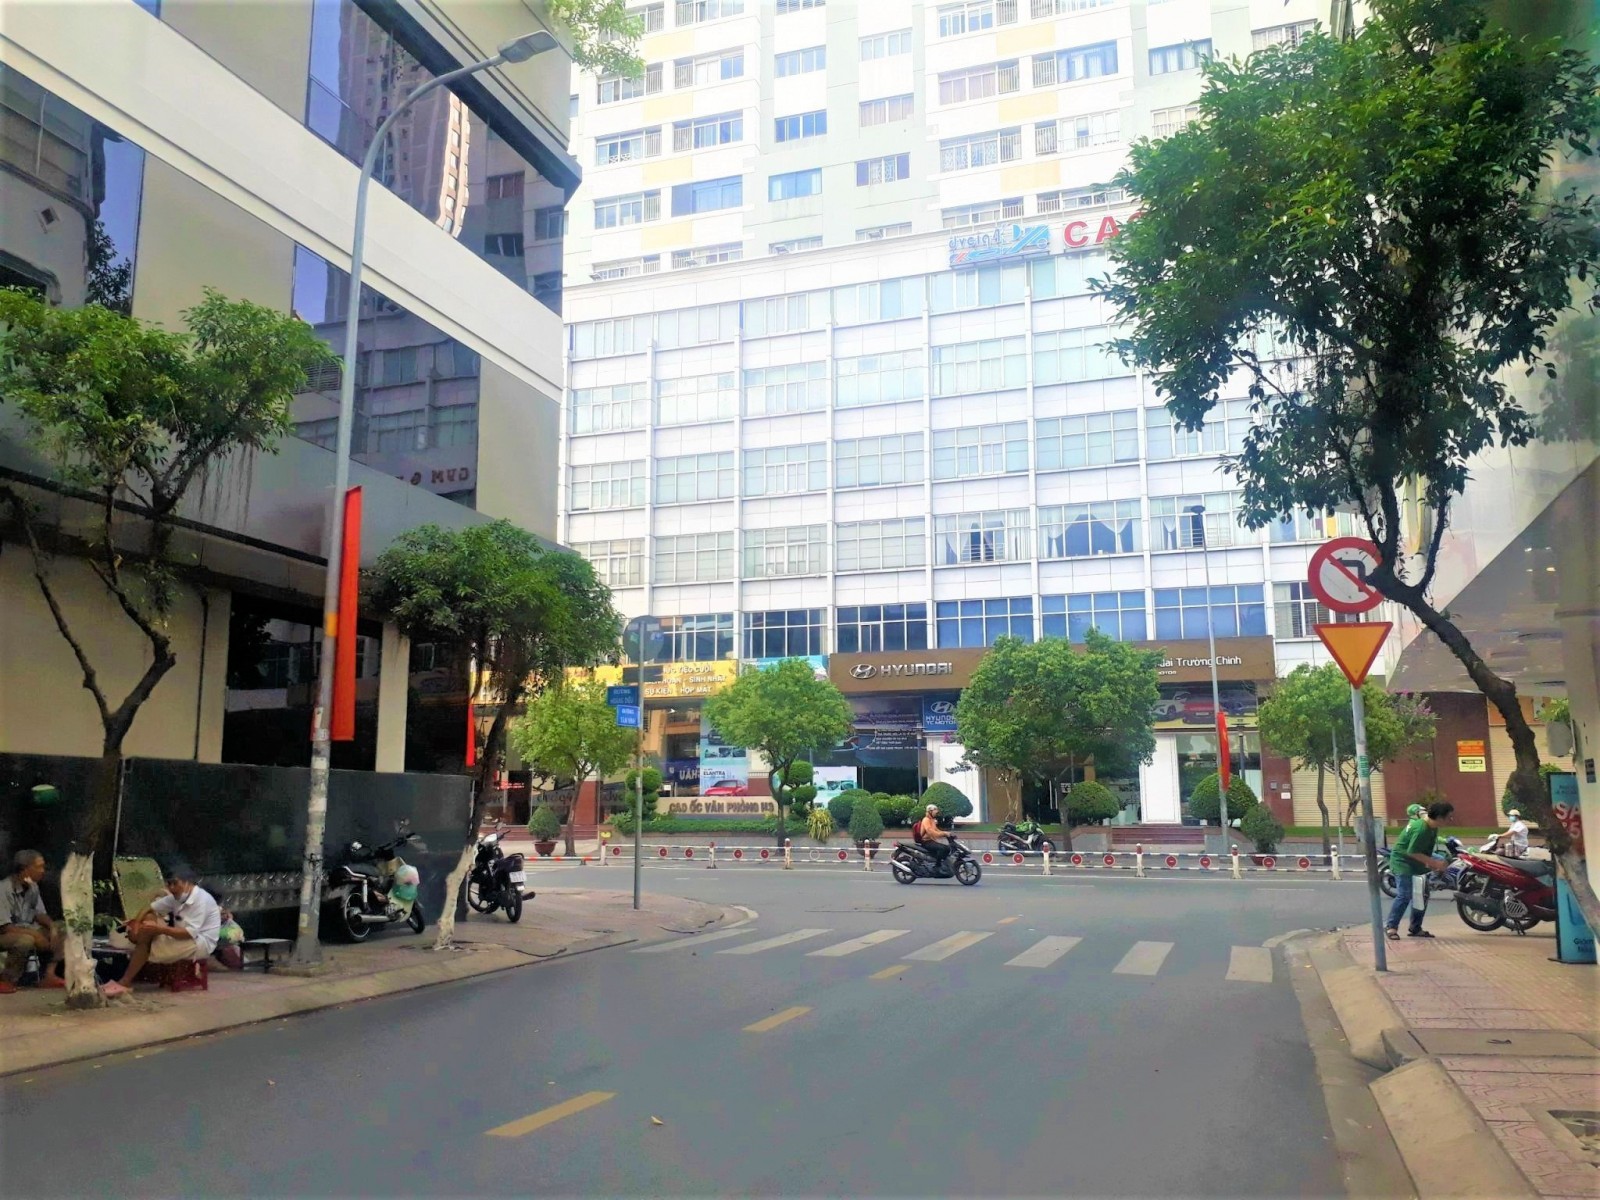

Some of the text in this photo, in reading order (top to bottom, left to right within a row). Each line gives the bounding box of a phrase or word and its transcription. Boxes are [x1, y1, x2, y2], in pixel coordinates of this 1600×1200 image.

[1176, 657, 1213, 668] Trường
[1215, 655, 1242, 665] Chinh
[880, 661, 953, 677] HYUNDAI
[668, 802, 688, 814] CAO
